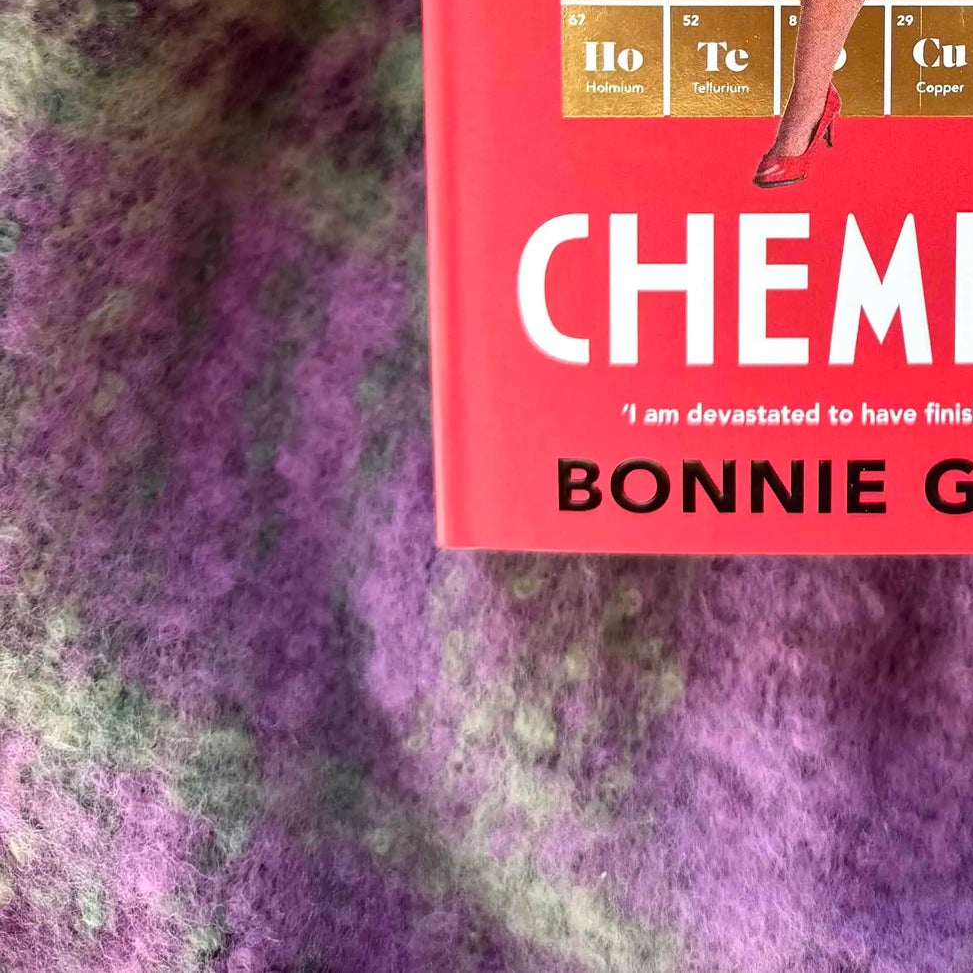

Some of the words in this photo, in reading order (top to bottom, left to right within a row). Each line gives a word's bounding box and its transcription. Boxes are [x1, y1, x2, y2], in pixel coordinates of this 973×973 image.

[568, 13, 586, 26] 67
[683, 14, 700, 27] 52
[896, 14, 914, 26] 29
[584, 41, 644, 72] Ho
[697, 41, 750, 72] Te
[912, 38, 968, 68] Cu
[586, 81, 644, 94] Holmium
[692, 81, 749, 94] Tellurium
[916, 81, 965, 96] Copper
[644, 408, 680, 426] am
[687, 402, 821, 426] devastated
[828, 405, 854, 426] to
[861, 402, 918, 425] have
[557, 458, 887, 515] BONNIE
